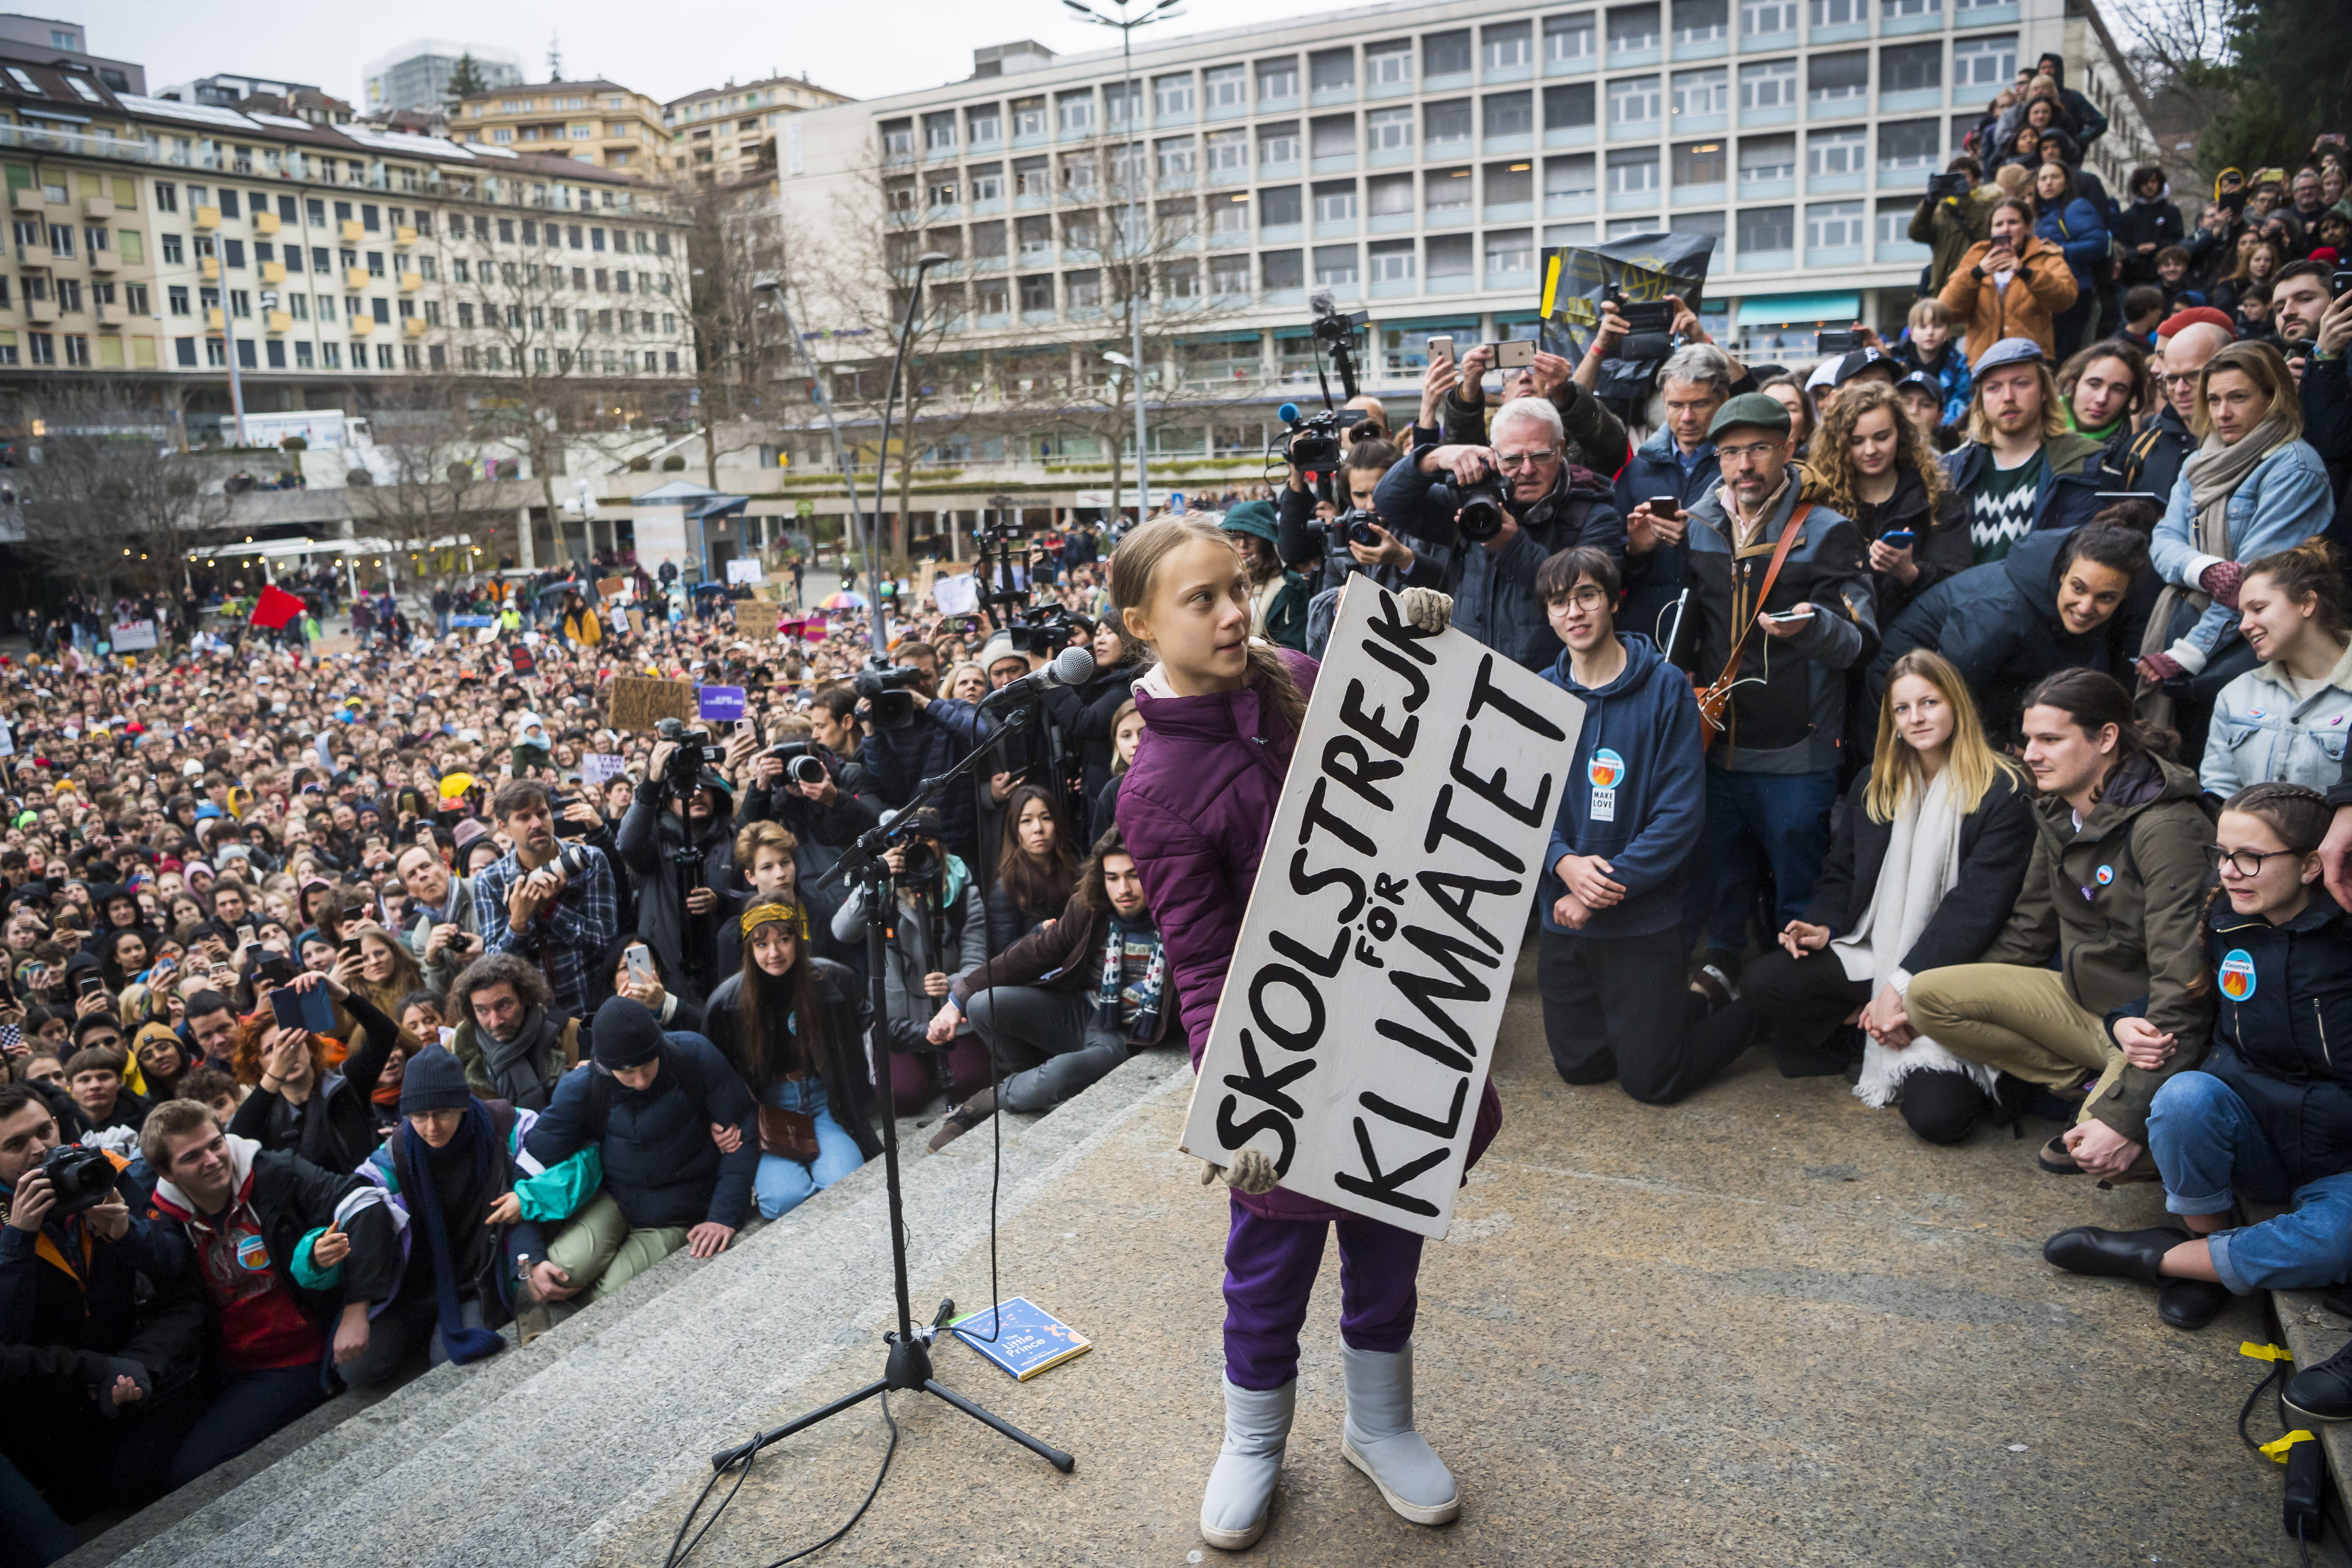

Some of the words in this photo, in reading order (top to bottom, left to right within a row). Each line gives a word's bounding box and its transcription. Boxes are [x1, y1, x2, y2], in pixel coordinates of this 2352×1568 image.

[1593, 800, 1612, 808] LOVE
[1594, 791, 1612, 799] MAKE
[1217, 591, 1446, 1180] SKOLSTREJK
[1355, 872, 1409, 969] FÖR
[1335, 653, 1566, 1217] KLIMATET
[1002, 1335, 1034, 1350] Little
[1005, 1339, 1046, 1357] Prince
